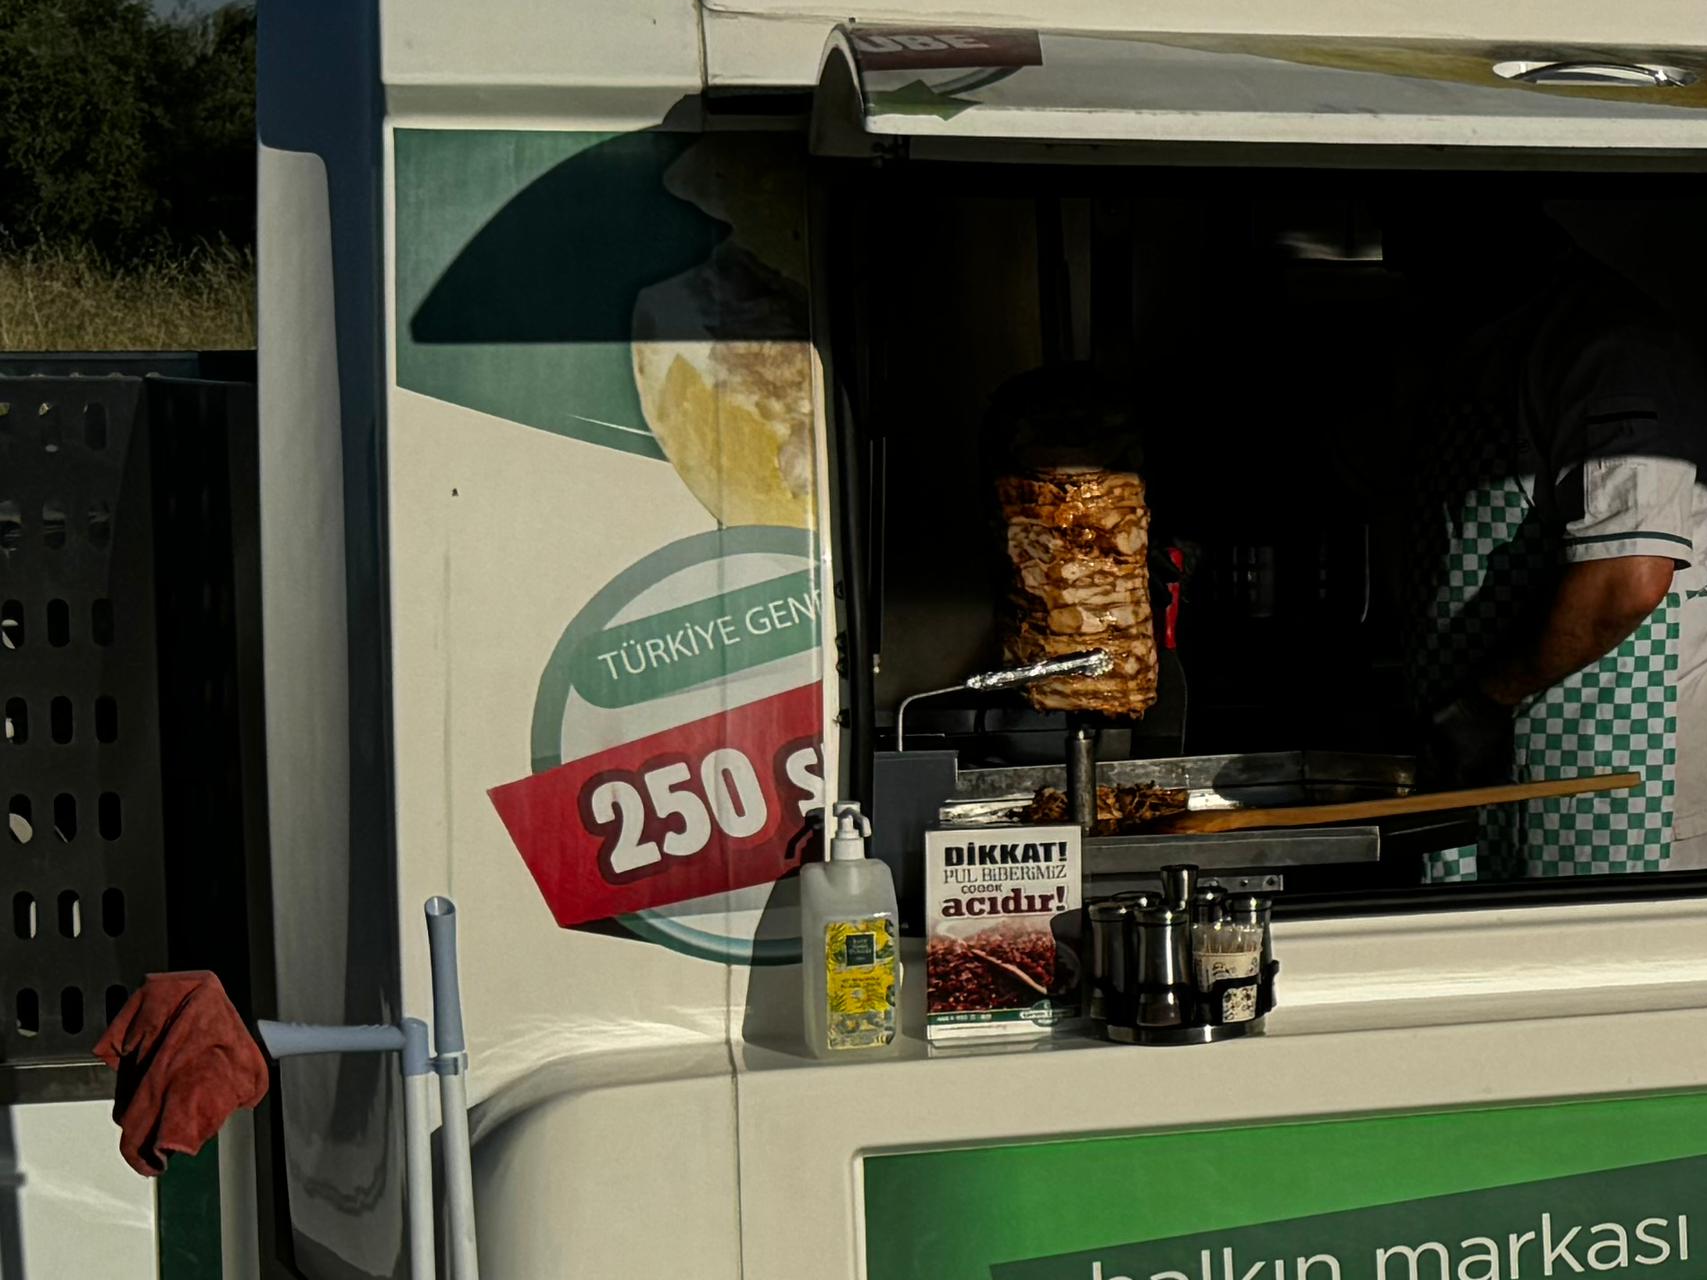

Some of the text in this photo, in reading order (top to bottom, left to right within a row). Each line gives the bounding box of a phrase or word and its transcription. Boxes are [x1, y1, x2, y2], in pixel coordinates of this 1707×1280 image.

[597, 616, 740, 680] TÜRKİYE
[591, 748, 768, 874] 250
[944, 841, 1067, 867] DİKKAT!
[944, 868, 978, 884] PUL
[941, 885, 1066, 917] acıdır!
